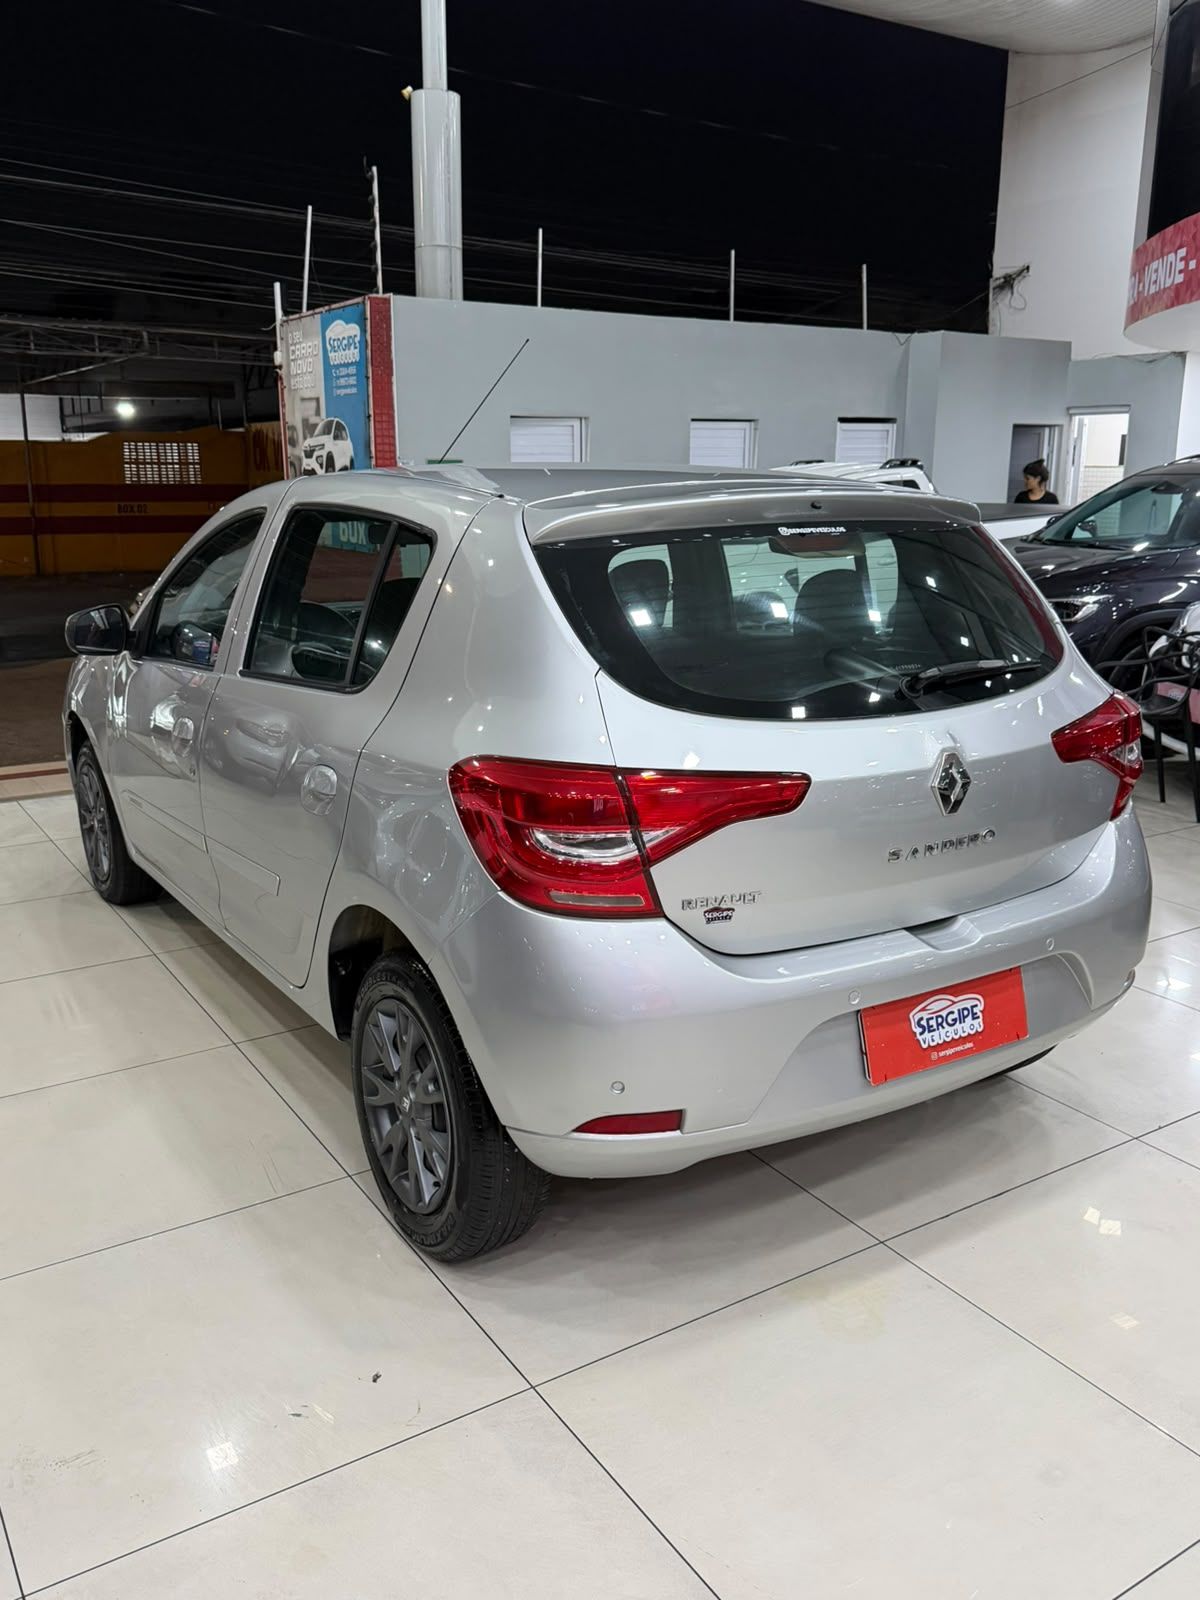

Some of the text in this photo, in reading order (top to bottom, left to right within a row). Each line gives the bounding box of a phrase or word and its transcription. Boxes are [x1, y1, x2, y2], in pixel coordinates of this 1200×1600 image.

[1144, 246, 1187, 297] VENDE
[289, 340, 319, 360] CARRO
[328, 334, 358, 353] SERGIPE
[290, 358, 313, 375] NOVO
[117, 503, 136, 514] BOX
[887, 828, 996, 863] SANDERO
[681, 889, 763, 911] RENAULT
[916, 1004, 981, 1036] SERGIPE
[921, 1020, 983, 1044] VEÍCULOS
